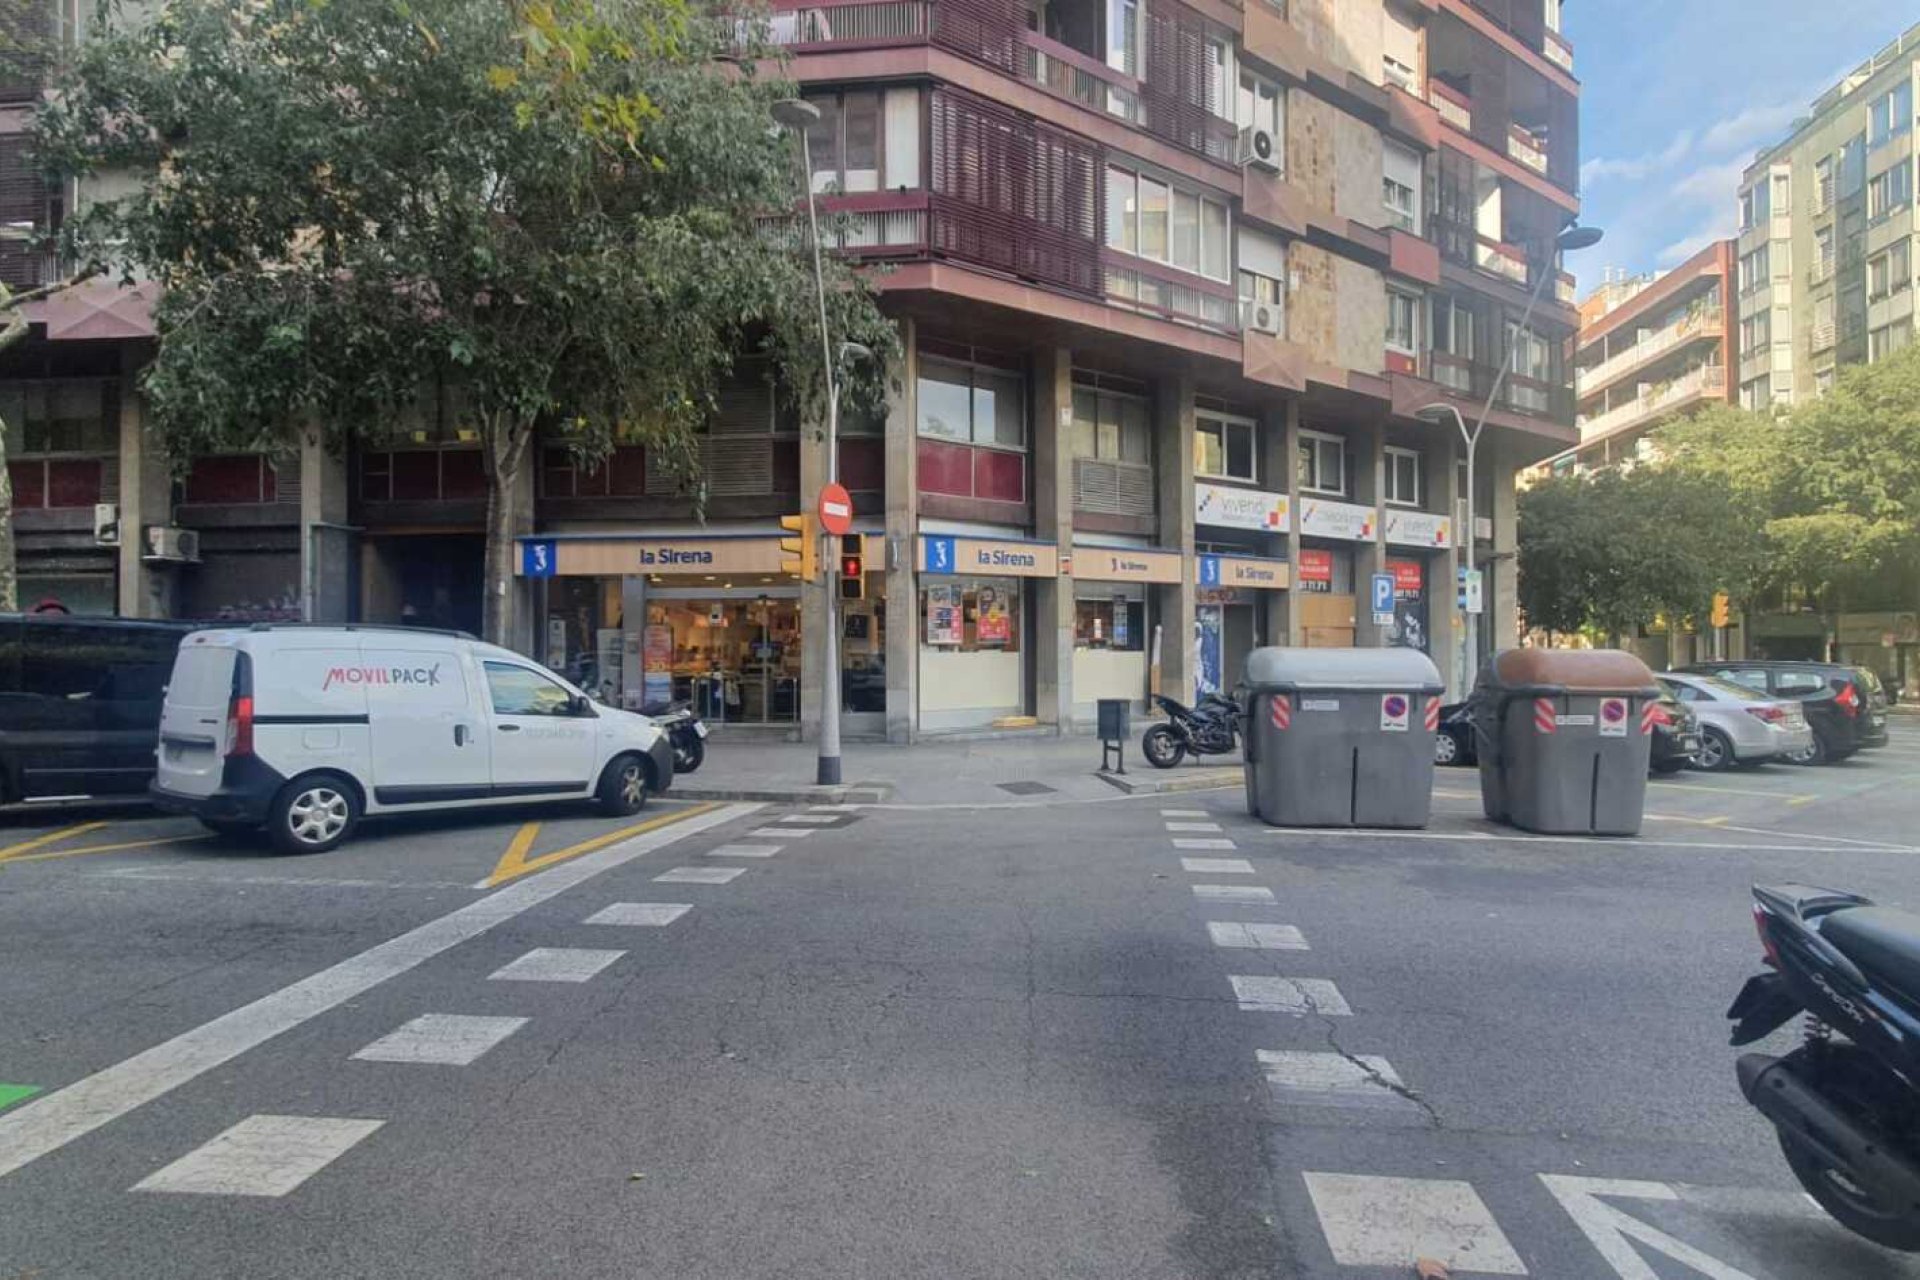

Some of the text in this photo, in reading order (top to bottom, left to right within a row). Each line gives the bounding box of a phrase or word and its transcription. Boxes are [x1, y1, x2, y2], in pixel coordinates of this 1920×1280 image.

[640, 548, 713, 565] la Sirena
[978, 549, 1035, 567] la Sirena
[1235, 565, 1274, 580] la Sirena
[1377, 580, 1391, 608] P
